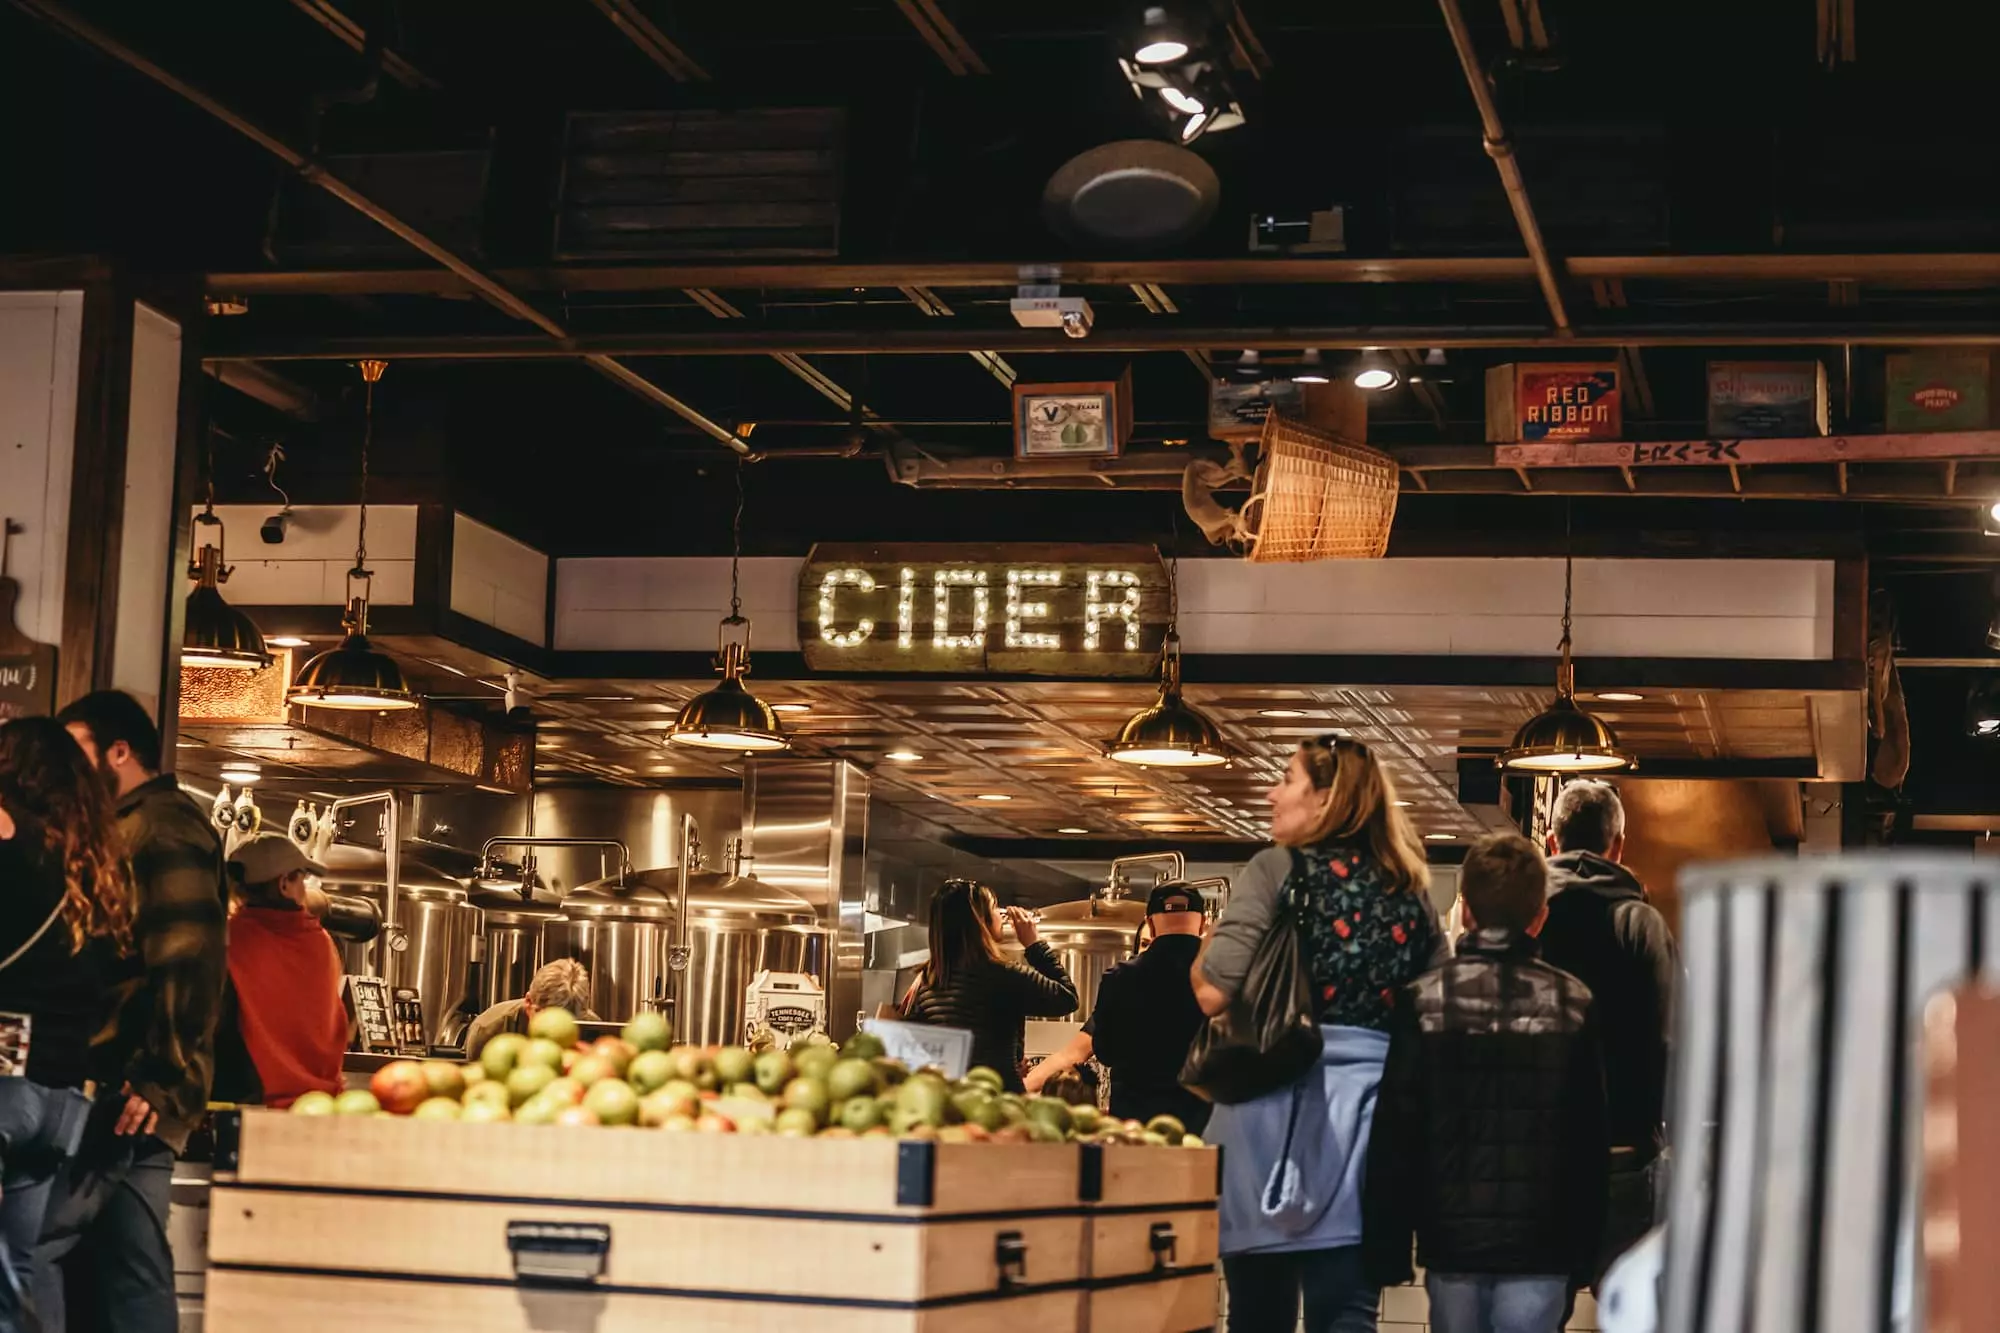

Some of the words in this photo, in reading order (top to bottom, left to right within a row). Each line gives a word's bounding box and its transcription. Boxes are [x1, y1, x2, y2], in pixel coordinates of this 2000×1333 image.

[1546, 387, 1588, 404] RED
[1043, 406, 1059, 421] V
[1528, 405, 1608, 422] RIBBON
[818, 567, 1141, 649] CIDER
[771, 1009, 810, 1018] TENNESSEE
